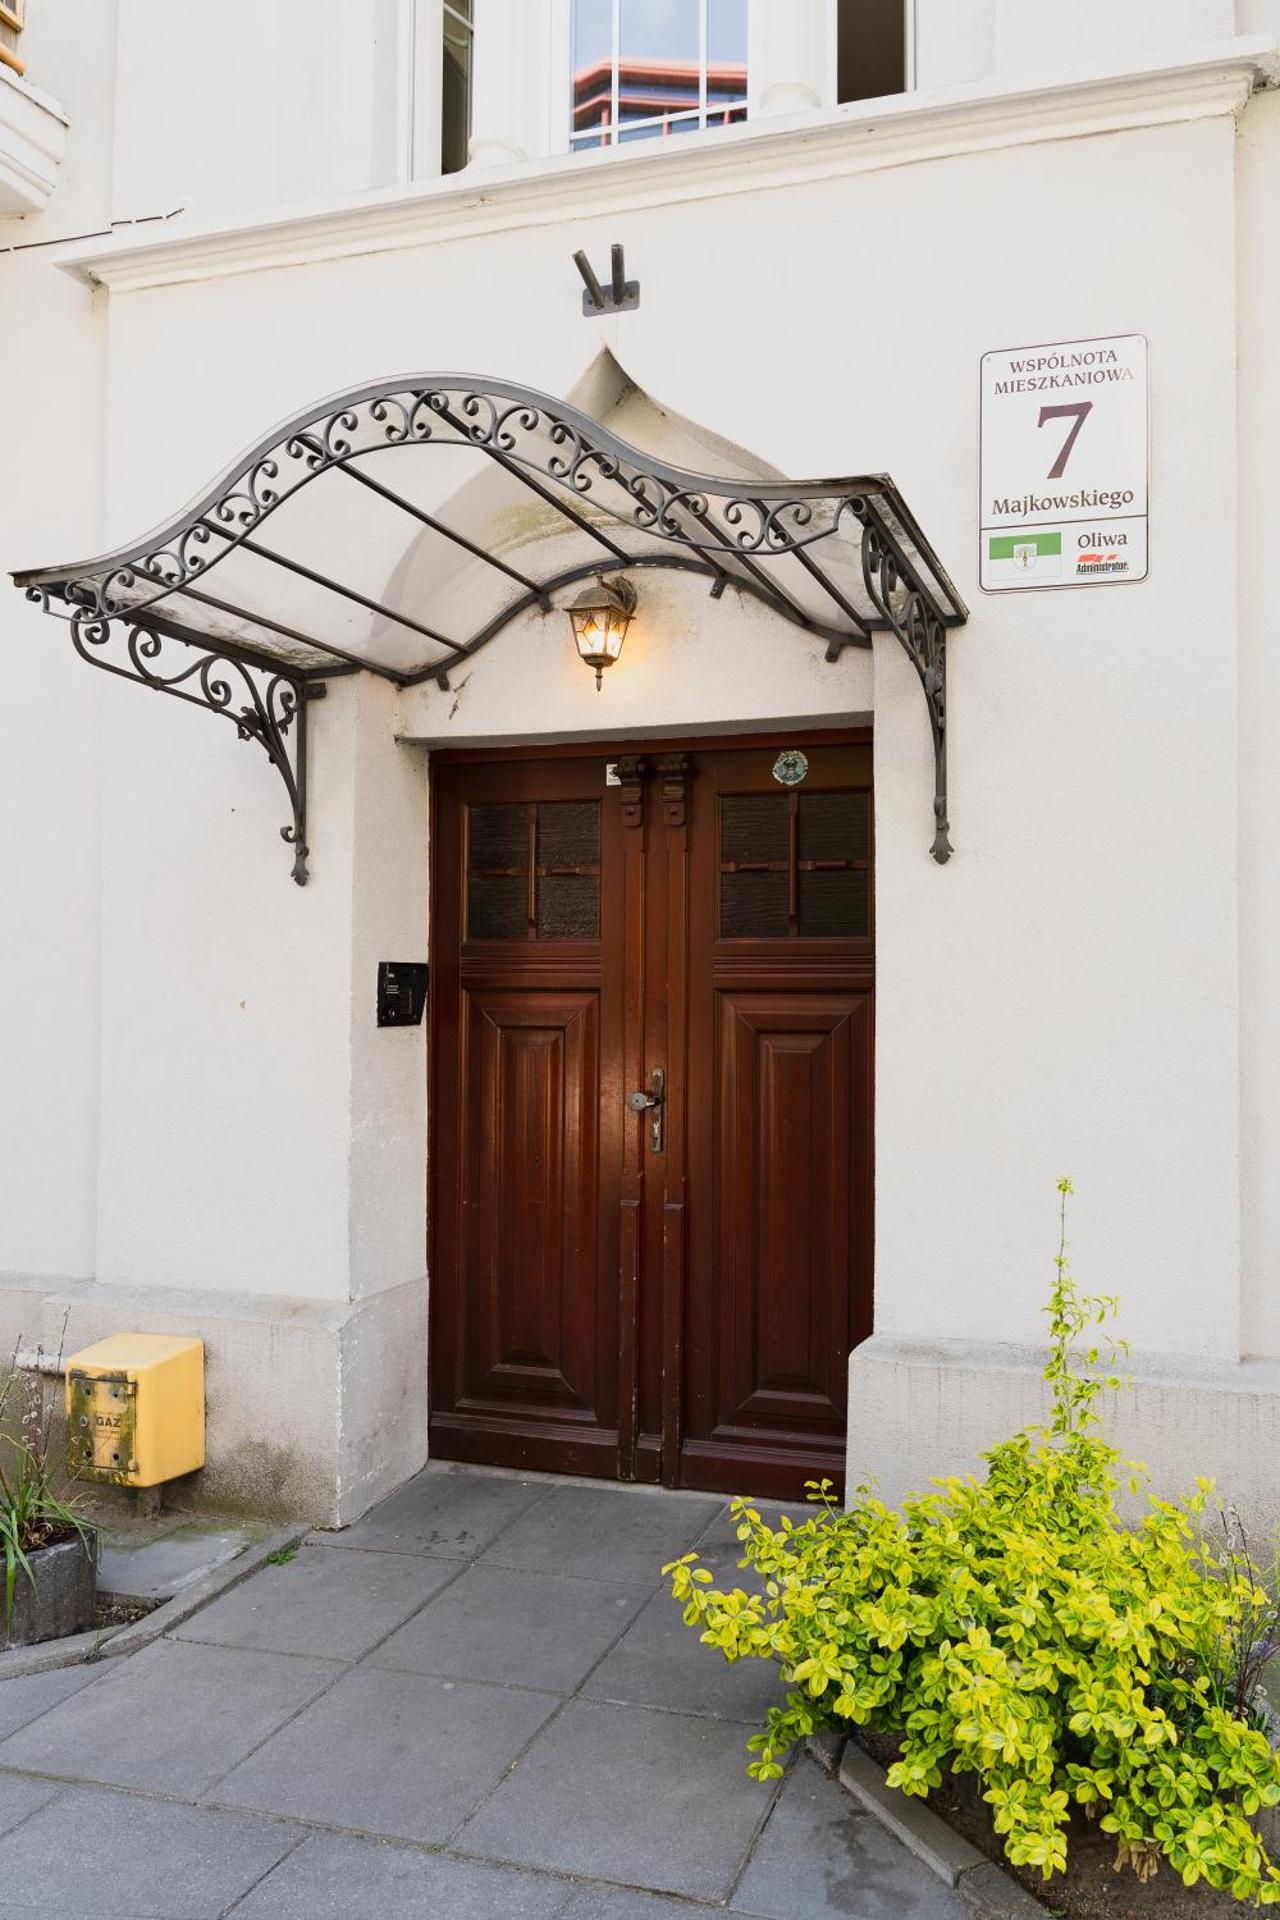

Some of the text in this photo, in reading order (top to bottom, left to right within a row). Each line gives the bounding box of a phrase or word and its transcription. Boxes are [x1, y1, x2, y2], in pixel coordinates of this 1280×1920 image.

[1009, 349, 1118, 374] WSPÓLNOTA
[994, 368, 1134, 395] MIESZKANIOWA
[1037, 401, 1094, 480] 7
[992, 489, 1134, 517] Majkowskiego
[1077, 532, 1128, 549] Oliwa
[96, 1416, 121, 1428] GAZ
